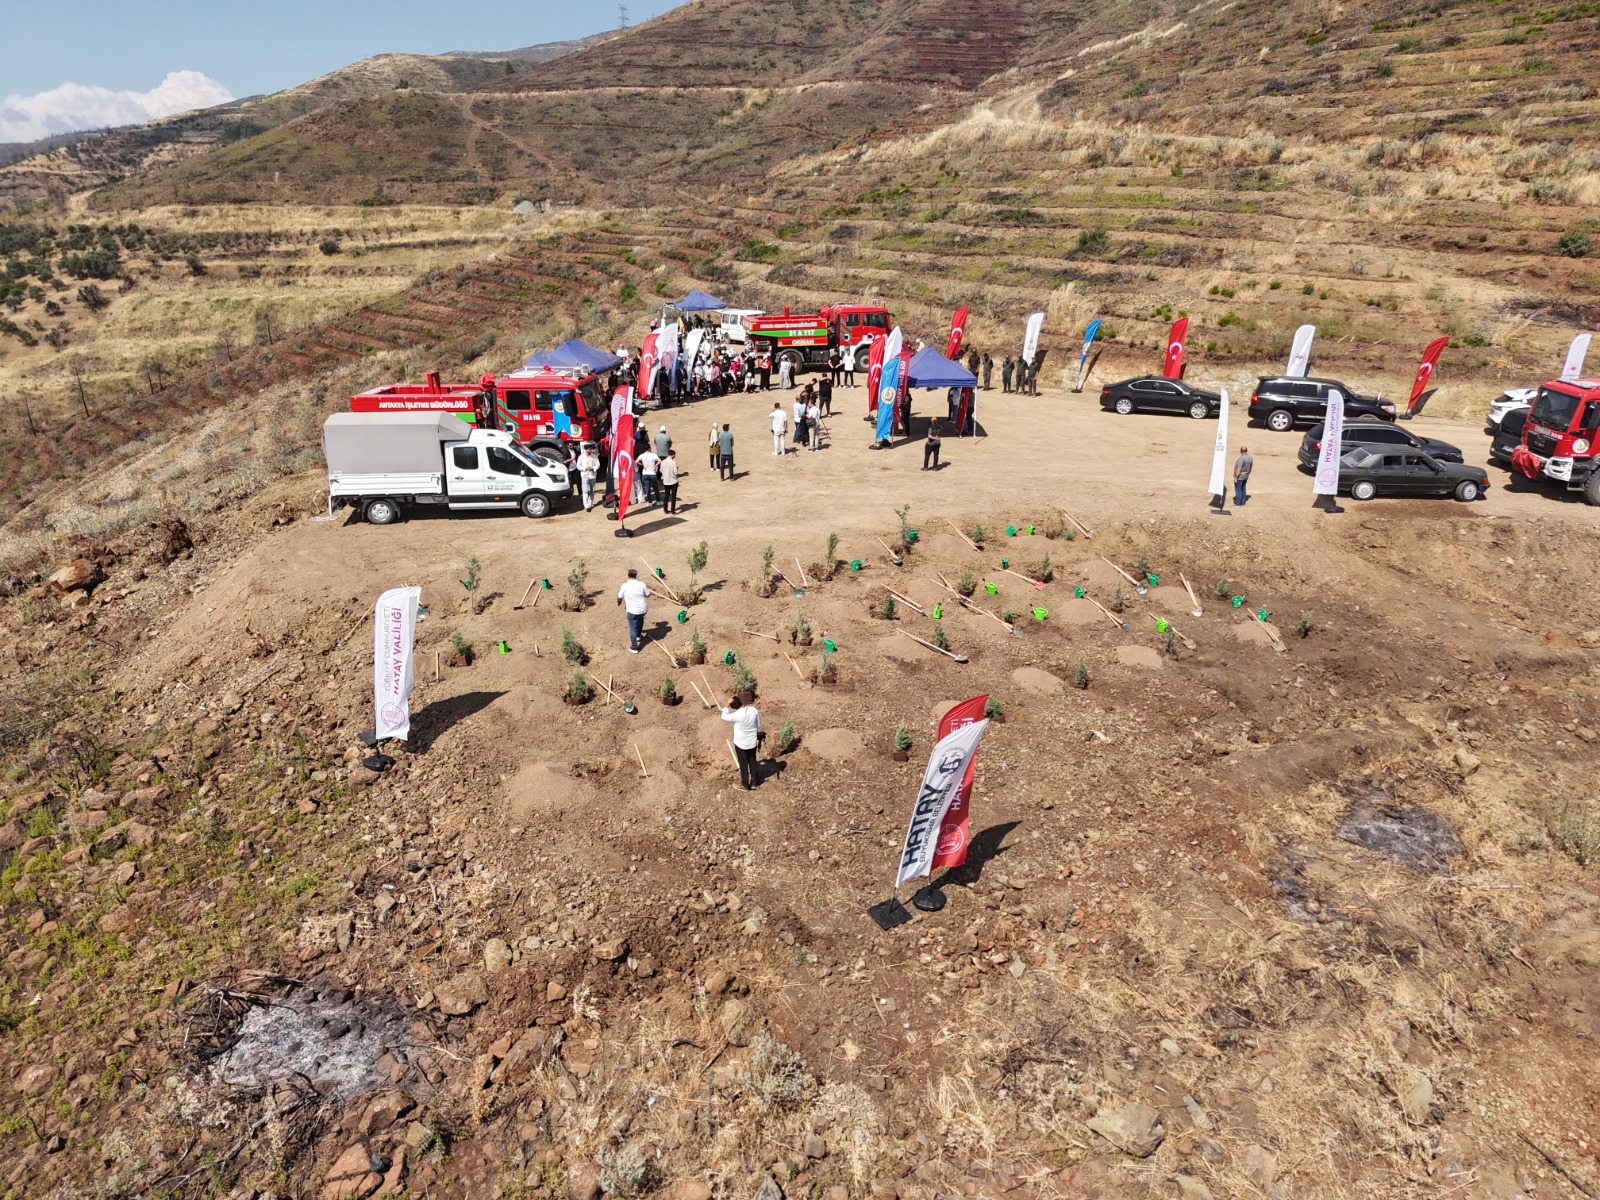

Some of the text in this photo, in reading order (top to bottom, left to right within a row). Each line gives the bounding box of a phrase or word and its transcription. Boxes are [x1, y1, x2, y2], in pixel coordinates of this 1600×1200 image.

[392, 608, 402, 694] HATAY VALİLİĞİ
[902, 784, 944, 868] HATAY
